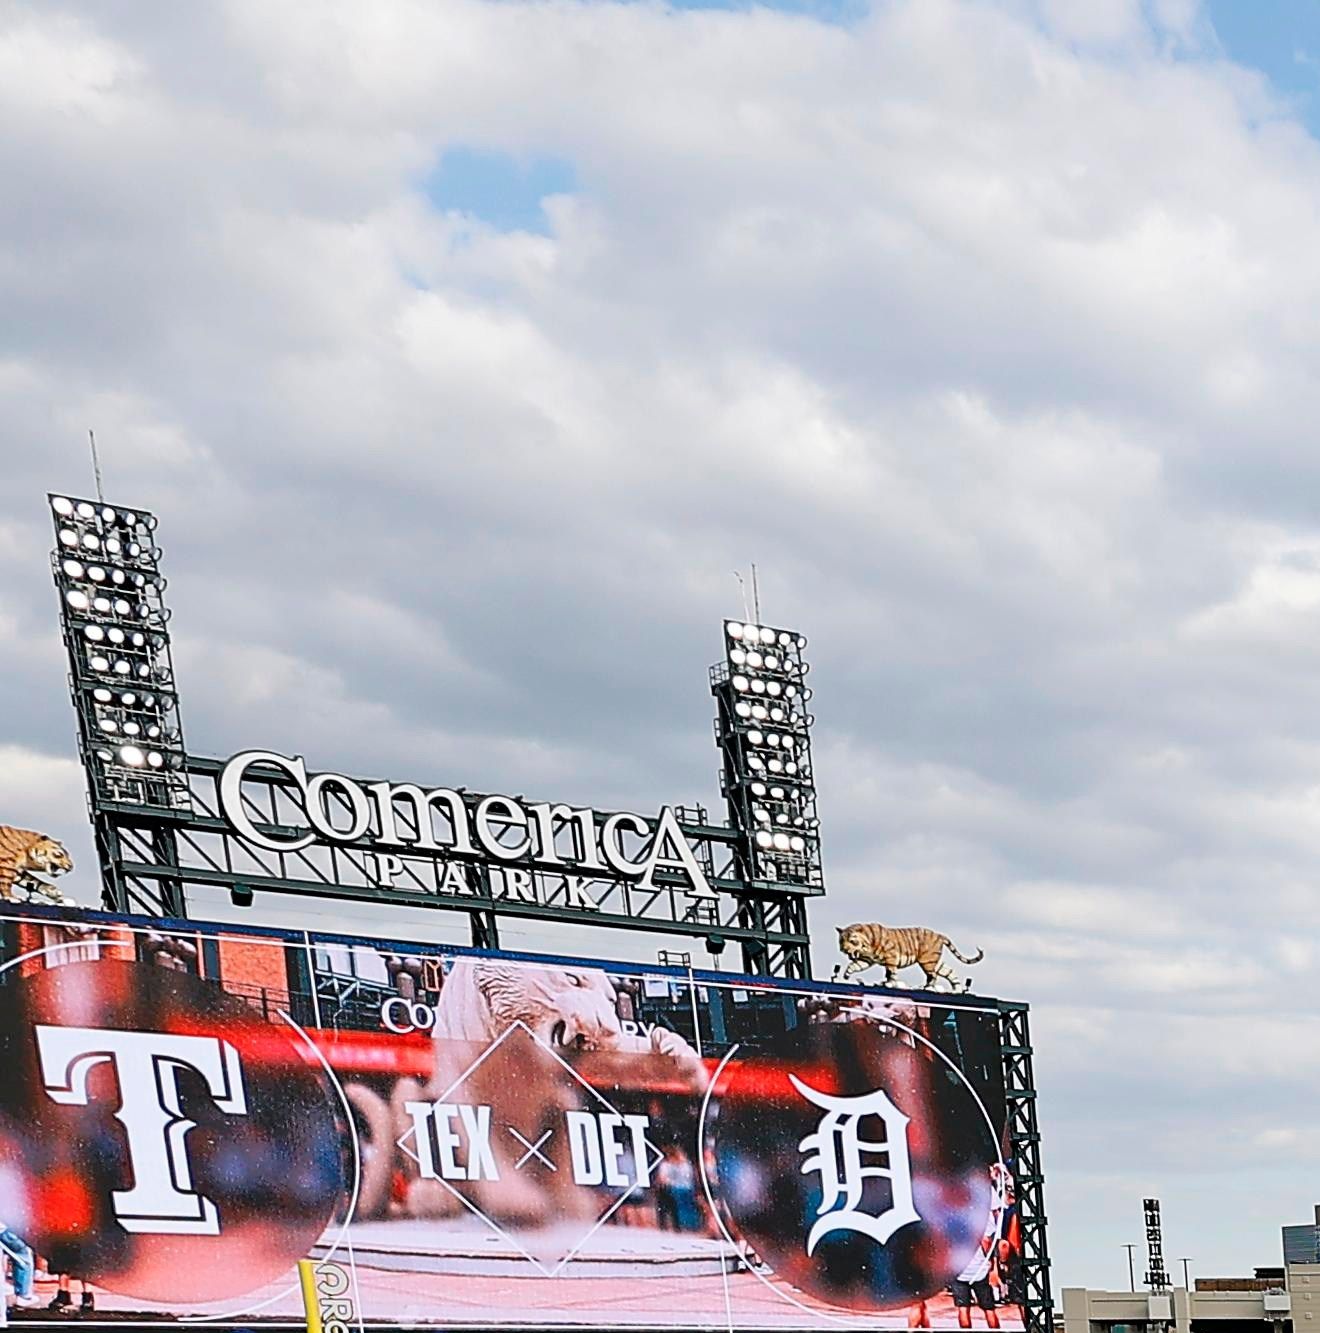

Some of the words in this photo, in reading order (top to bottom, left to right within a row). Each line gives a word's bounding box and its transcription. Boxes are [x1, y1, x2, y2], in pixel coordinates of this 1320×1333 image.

[380, 856, 600, 909] PARK
[34, 1024, 247, 1235] T
[405, 1101, 500, 1182] TEX
[566, 1110, 651, 1188] DET
[787, 1073, 921, 1257] D
